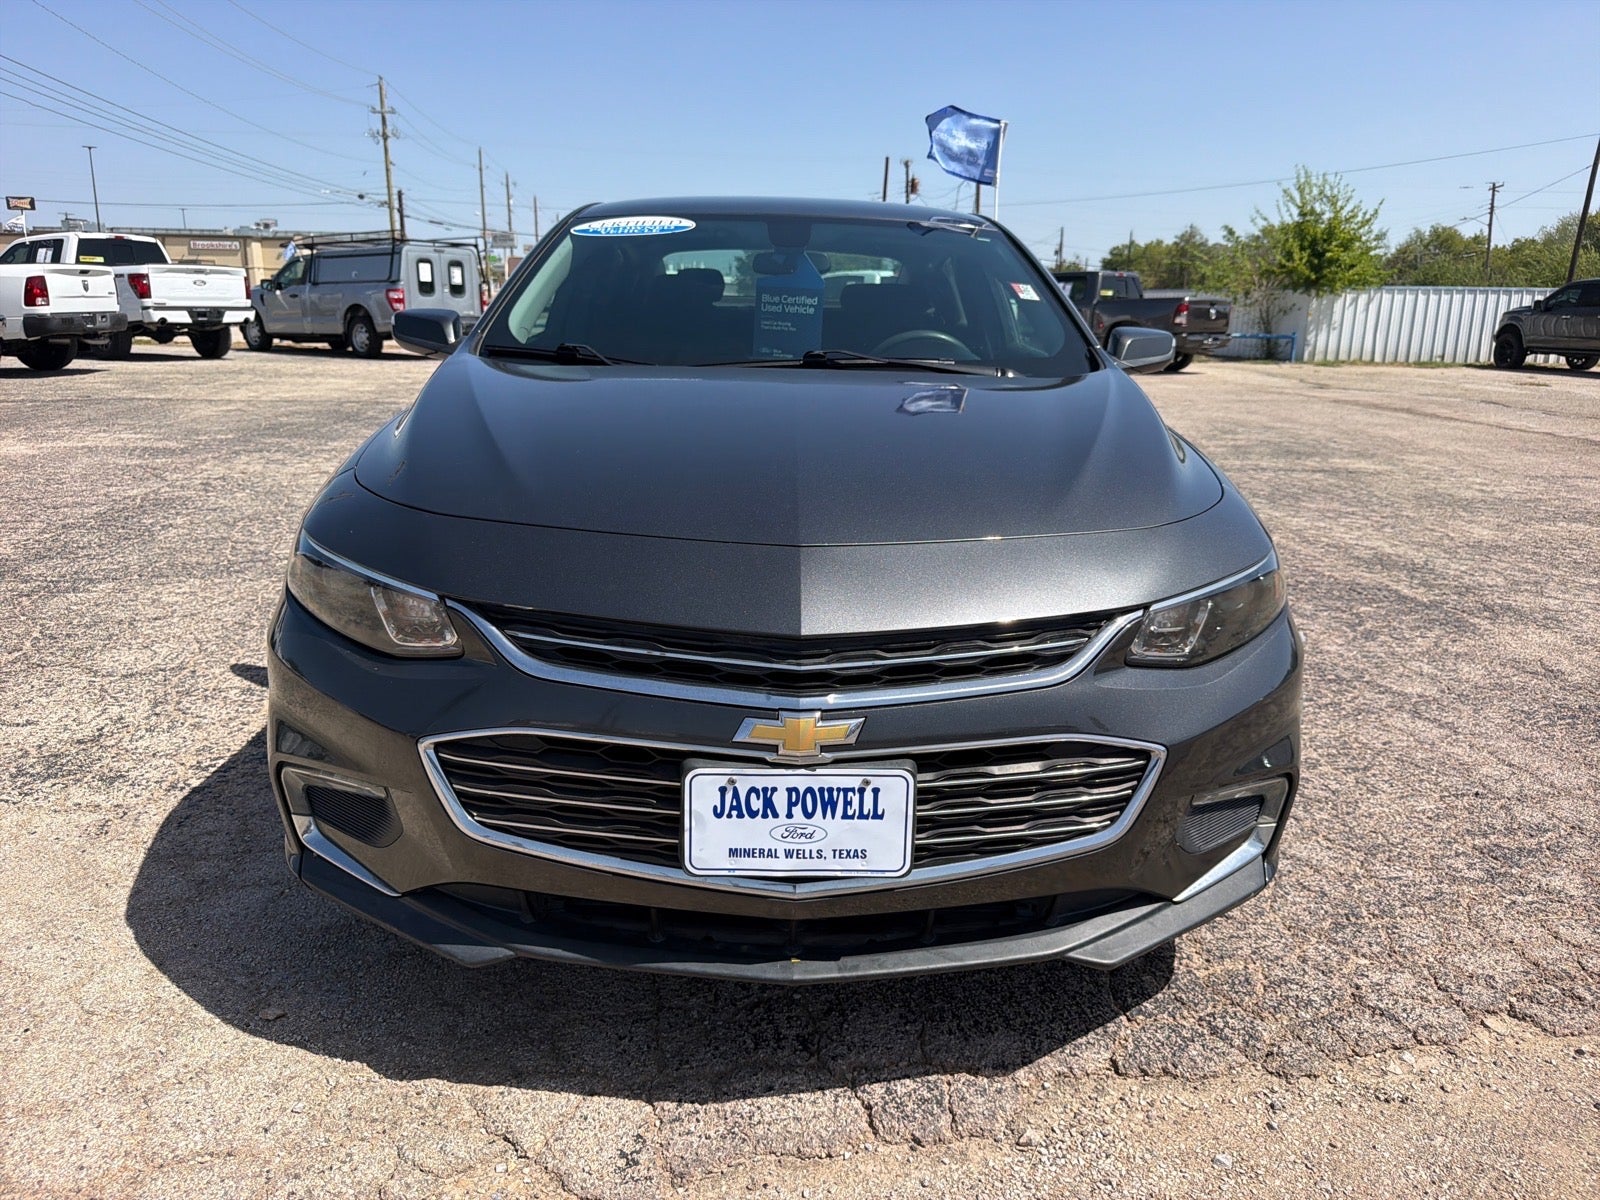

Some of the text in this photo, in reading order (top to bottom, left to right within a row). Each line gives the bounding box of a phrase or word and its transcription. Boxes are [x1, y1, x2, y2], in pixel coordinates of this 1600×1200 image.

[192, 240, 239, 249] Brookshire's
[761, 294, 818, 305] Blue Certified
[761, 303, 815, 314] Used Vehicle
[712, 785, 885, 820] JACK POWELL
[780, 825, 816, 840] Ford
[728, 847, 868, 860] MINERAL WELLS, TEXAS
